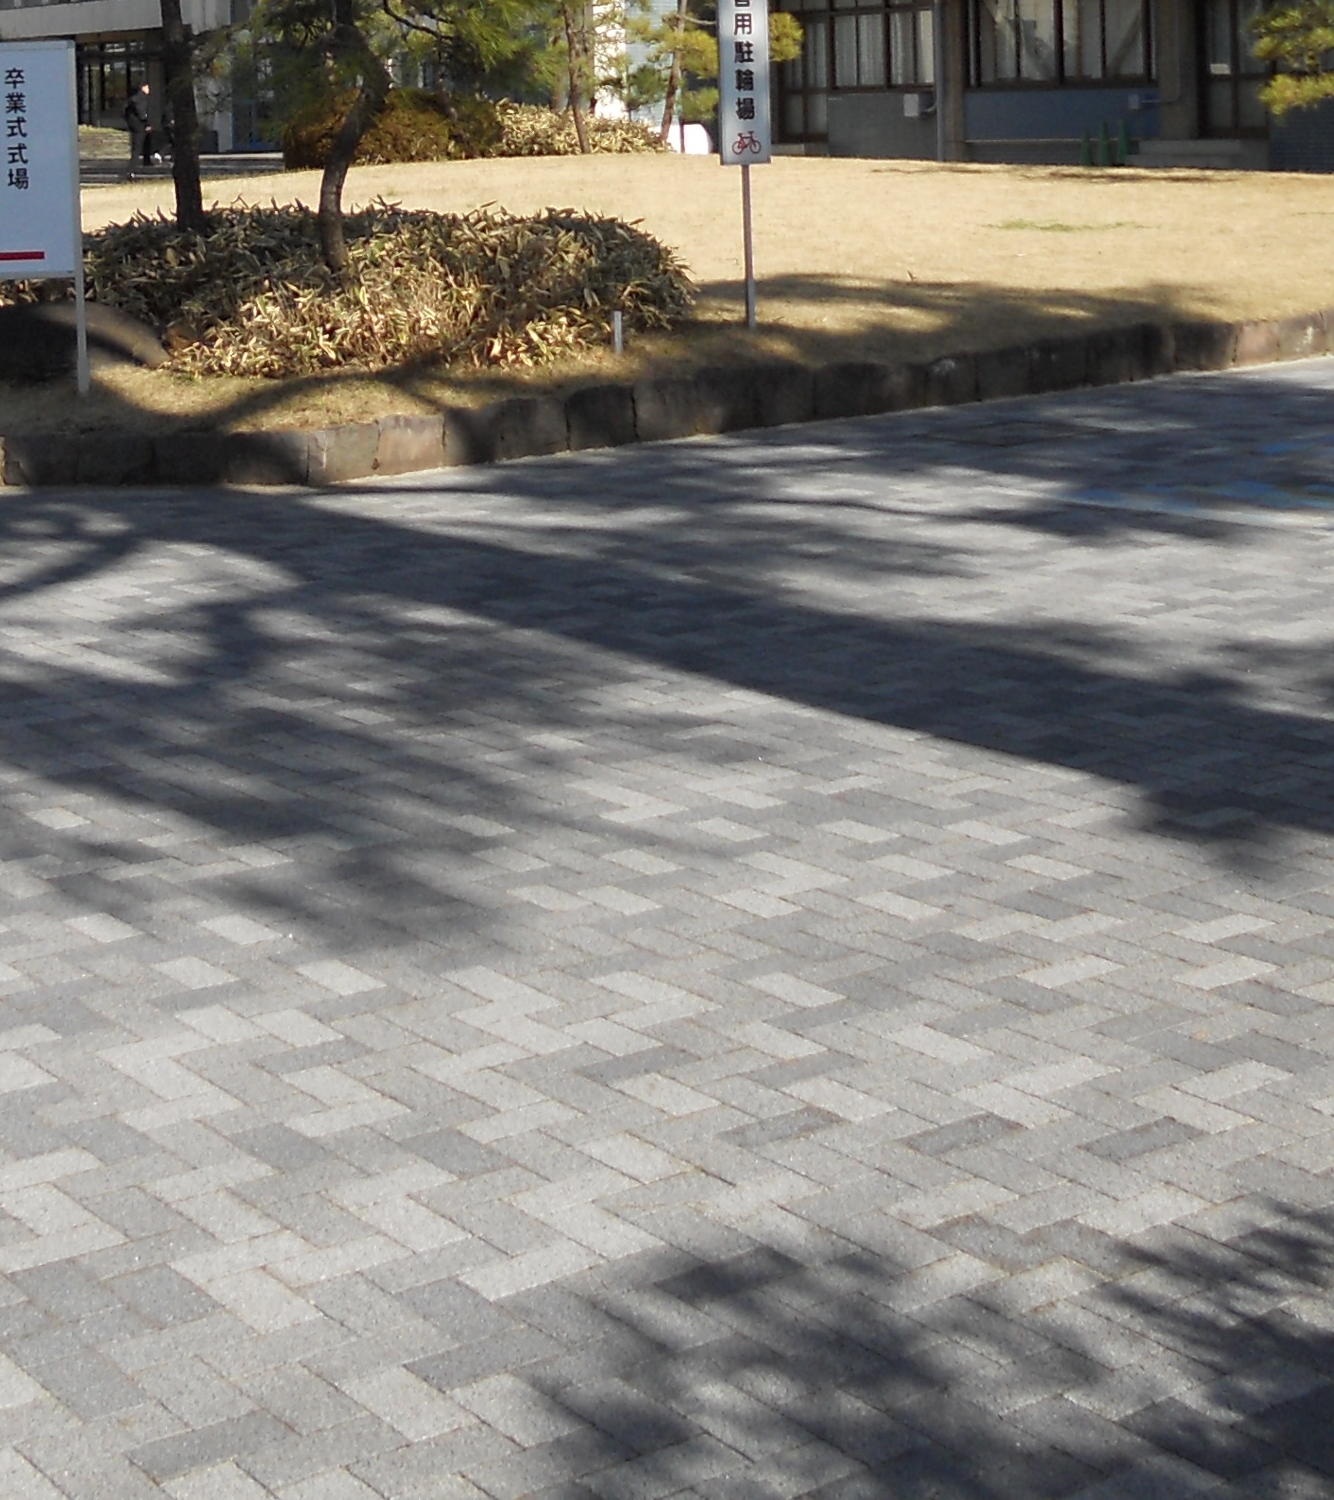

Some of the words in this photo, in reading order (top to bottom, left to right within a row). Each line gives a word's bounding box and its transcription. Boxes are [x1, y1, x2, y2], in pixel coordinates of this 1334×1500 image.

[4, 68, 29, 190] 卒業式式場
